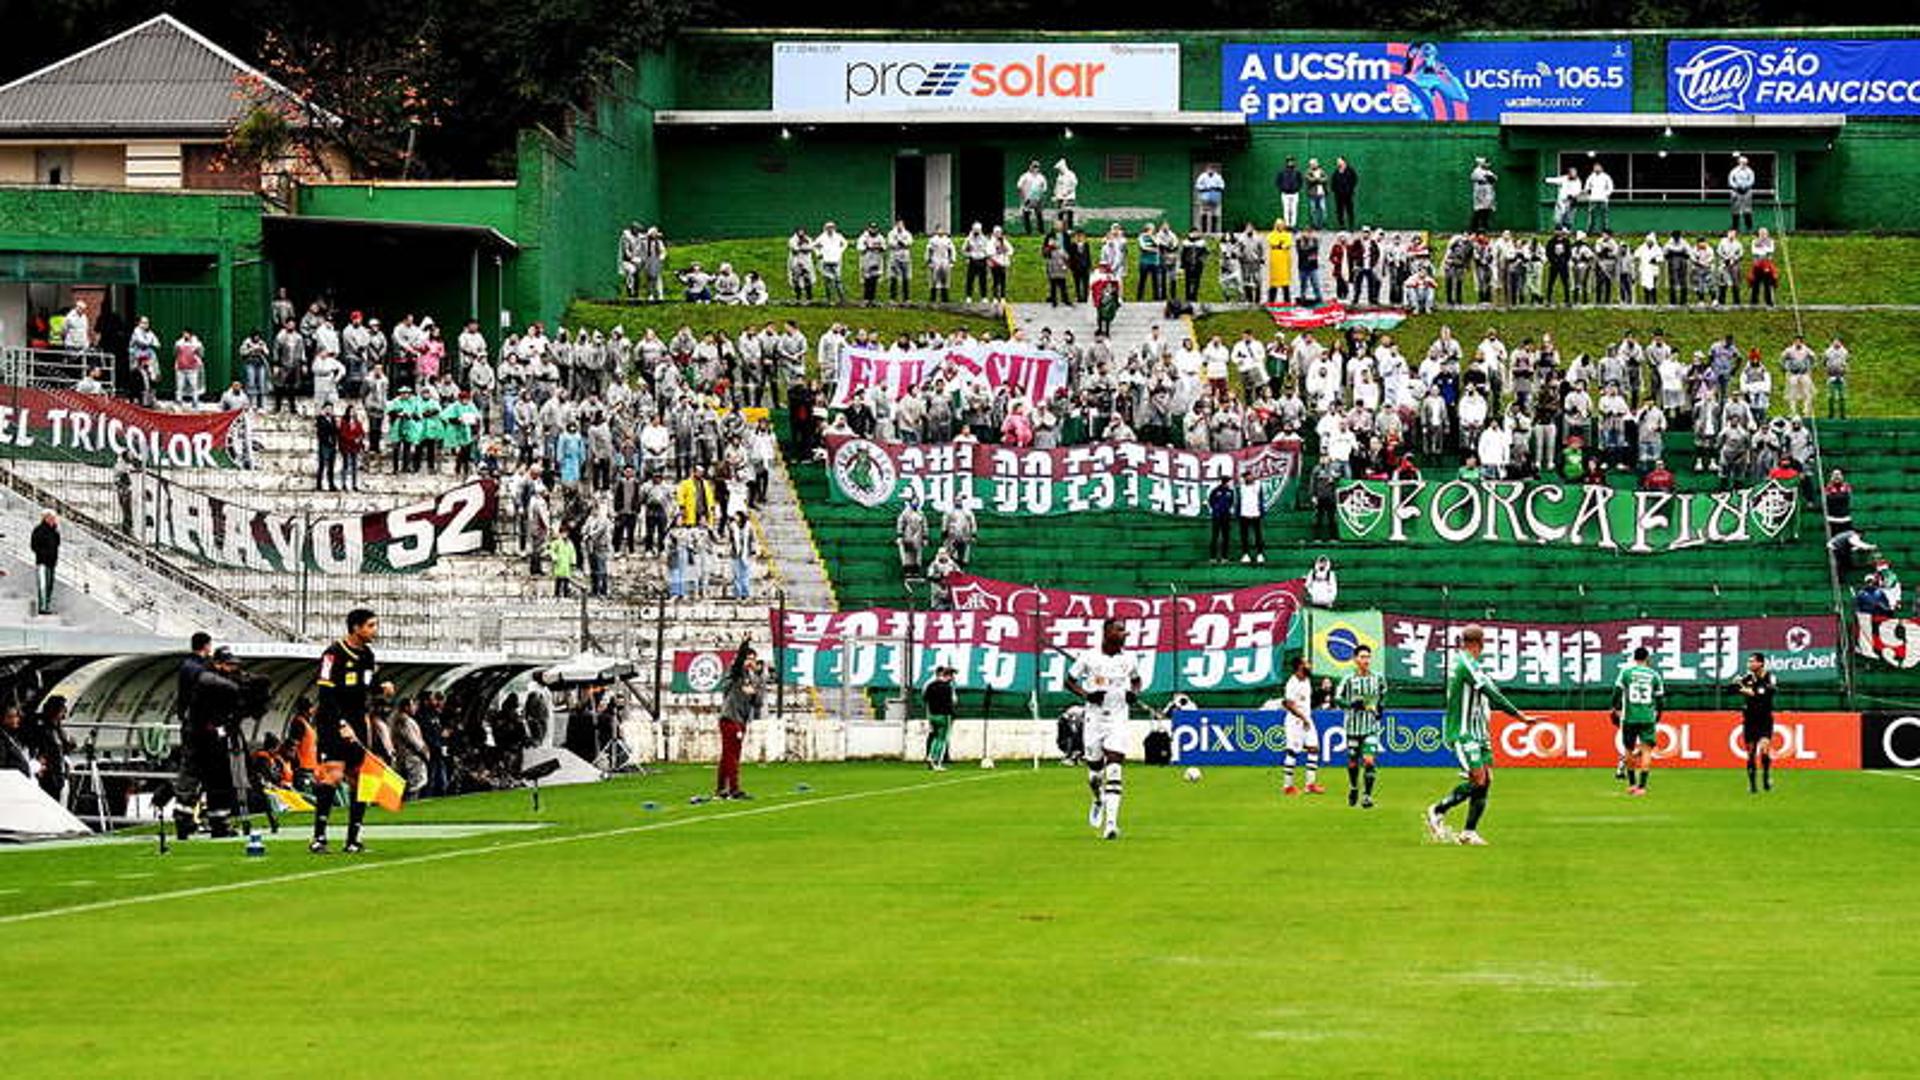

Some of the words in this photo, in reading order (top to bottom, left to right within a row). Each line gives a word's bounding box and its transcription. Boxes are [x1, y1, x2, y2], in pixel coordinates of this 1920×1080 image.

[1239, 54, 1267, 81] A
[1274, 53, 1391, 81] UCSfm
[1465, 69, 1541, 88] UCSfm
[1555, 66, 1624, 88] 106.5
[1757, 48, 1820, 76] SÃO
[1240, 88, 1261, 114] é
[1267, 94, 1324, 119] pra
[1332, 88, 1422, 114] você.
[48, 408, 219, 467] TRICOLOR
[991, 449, 1053, 514] DO
[1062, 442, 1237, 517] ESTADO
[387, 480, 486, 569] 52
[783, 611, 1020, 692] YOUNG
[1186, 609, 1278, 688] 35
[1616, 624, 1742, 680] FLU
[1170, 714, 1287, 762] pixbe
[1501, 722, 1588, 758] GOL
